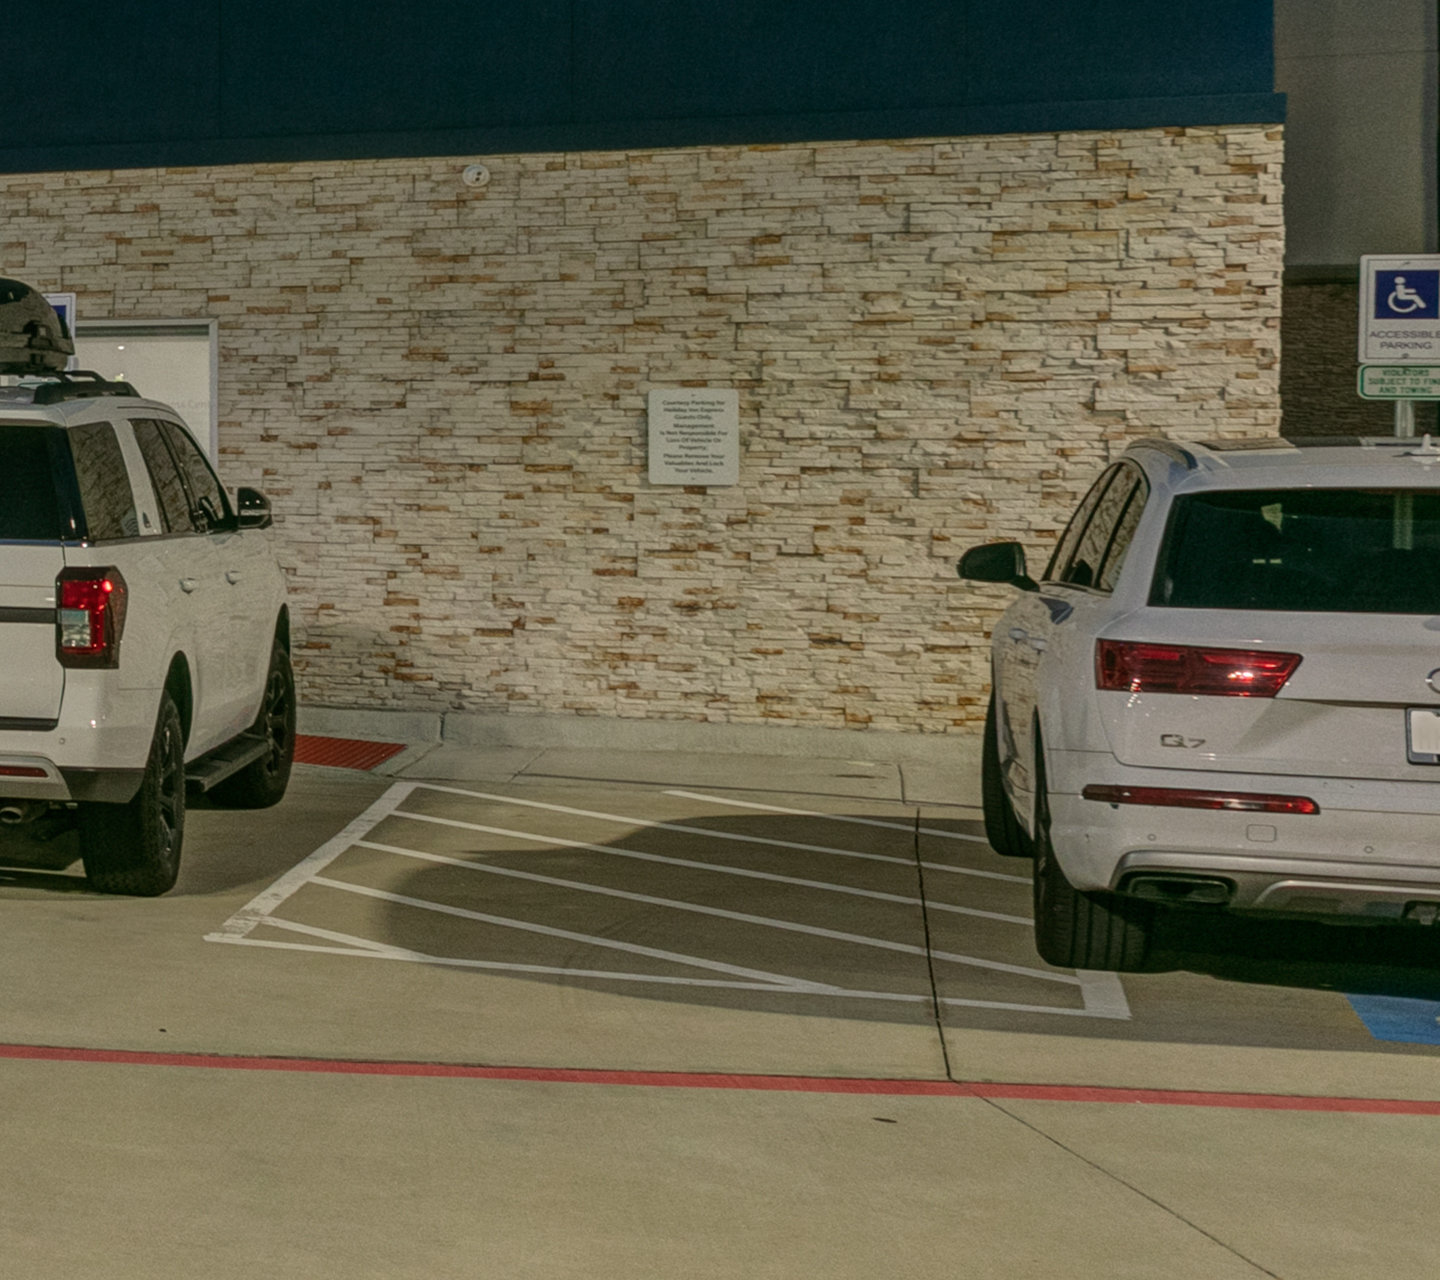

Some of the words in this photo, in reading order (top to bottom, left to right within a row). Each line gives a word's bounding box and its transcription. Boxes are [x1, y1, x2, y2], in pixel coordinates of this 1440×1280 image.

[1369, 330, 1440, 338] ACCESSIBLE
[1380, 341, 1433, 350] PARKING
[1379, 386, 1398, 394] AND
[1400, 386, 1433, 394] TOWING
[1160, 733, 1206, 748] Q7
